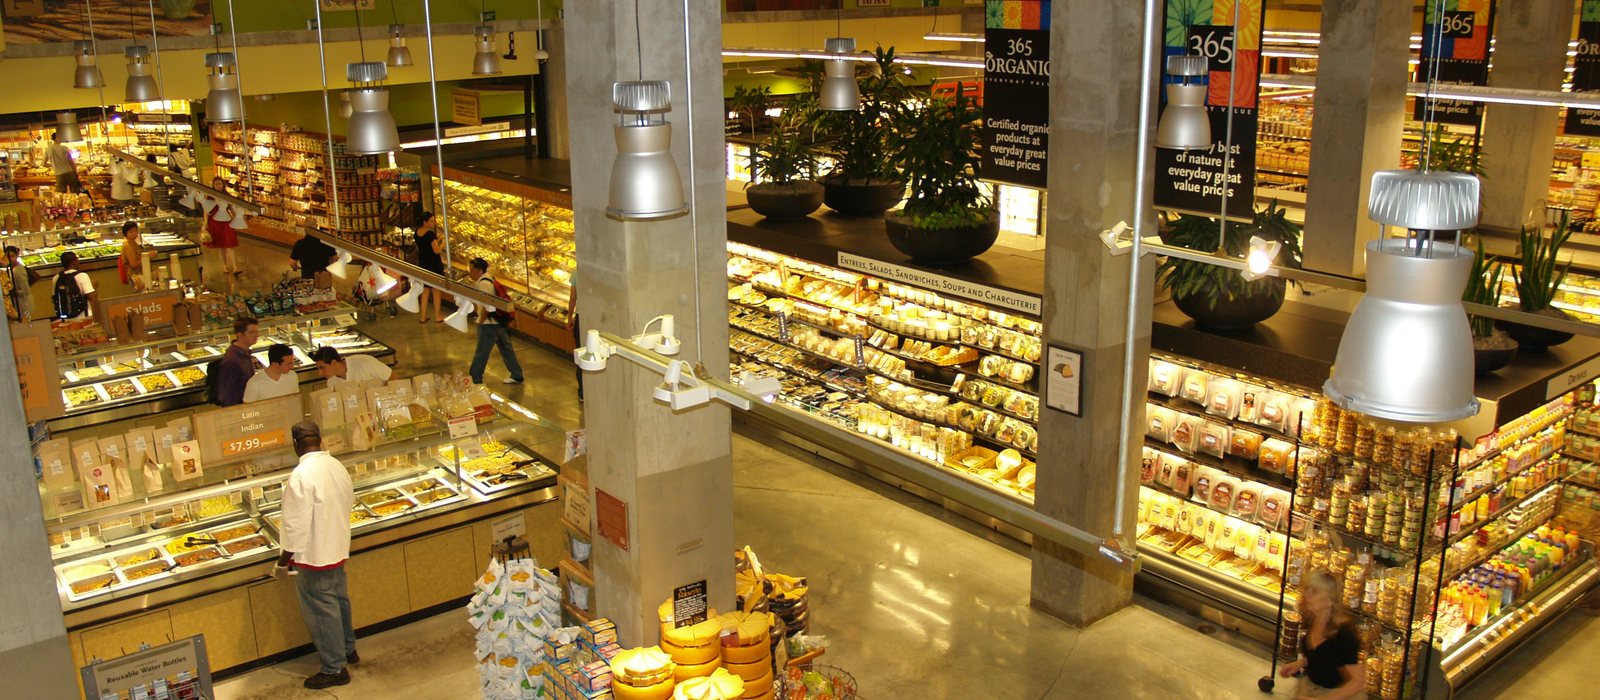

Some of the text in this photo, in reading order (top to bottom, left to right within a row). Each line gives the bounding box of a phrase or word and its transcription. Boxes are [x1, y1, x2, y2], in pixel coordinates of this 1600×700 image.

[1442, 14, 1473, 34] 365
[1007, 38, 1032, 56] 365
[1190, 30, 1234, 63] 365
[987, 118, 1020, 131] Certified
[996, 132, 1041, 146] products at
[990, 145, 1046, 160] everyday great
[1176, 151, 1188, 162] of
[1189, 154, 1222, 167] nature
[994, 157, 1041, 171] value prices
[1168, 167, 1212, 182] everyday
[1174, 180, 1200, 193] value
[942, 280, 966, 293] SOUPS
[242, 410, 260, 419] Latin
[241, 423, 264, 432] Indian
[230, 438, 260, 452] $7.99
[106, 669, 139, 684] Reusable
[140, 664, 161, 674] Water
[162, 656, 187, 667] Bottles
